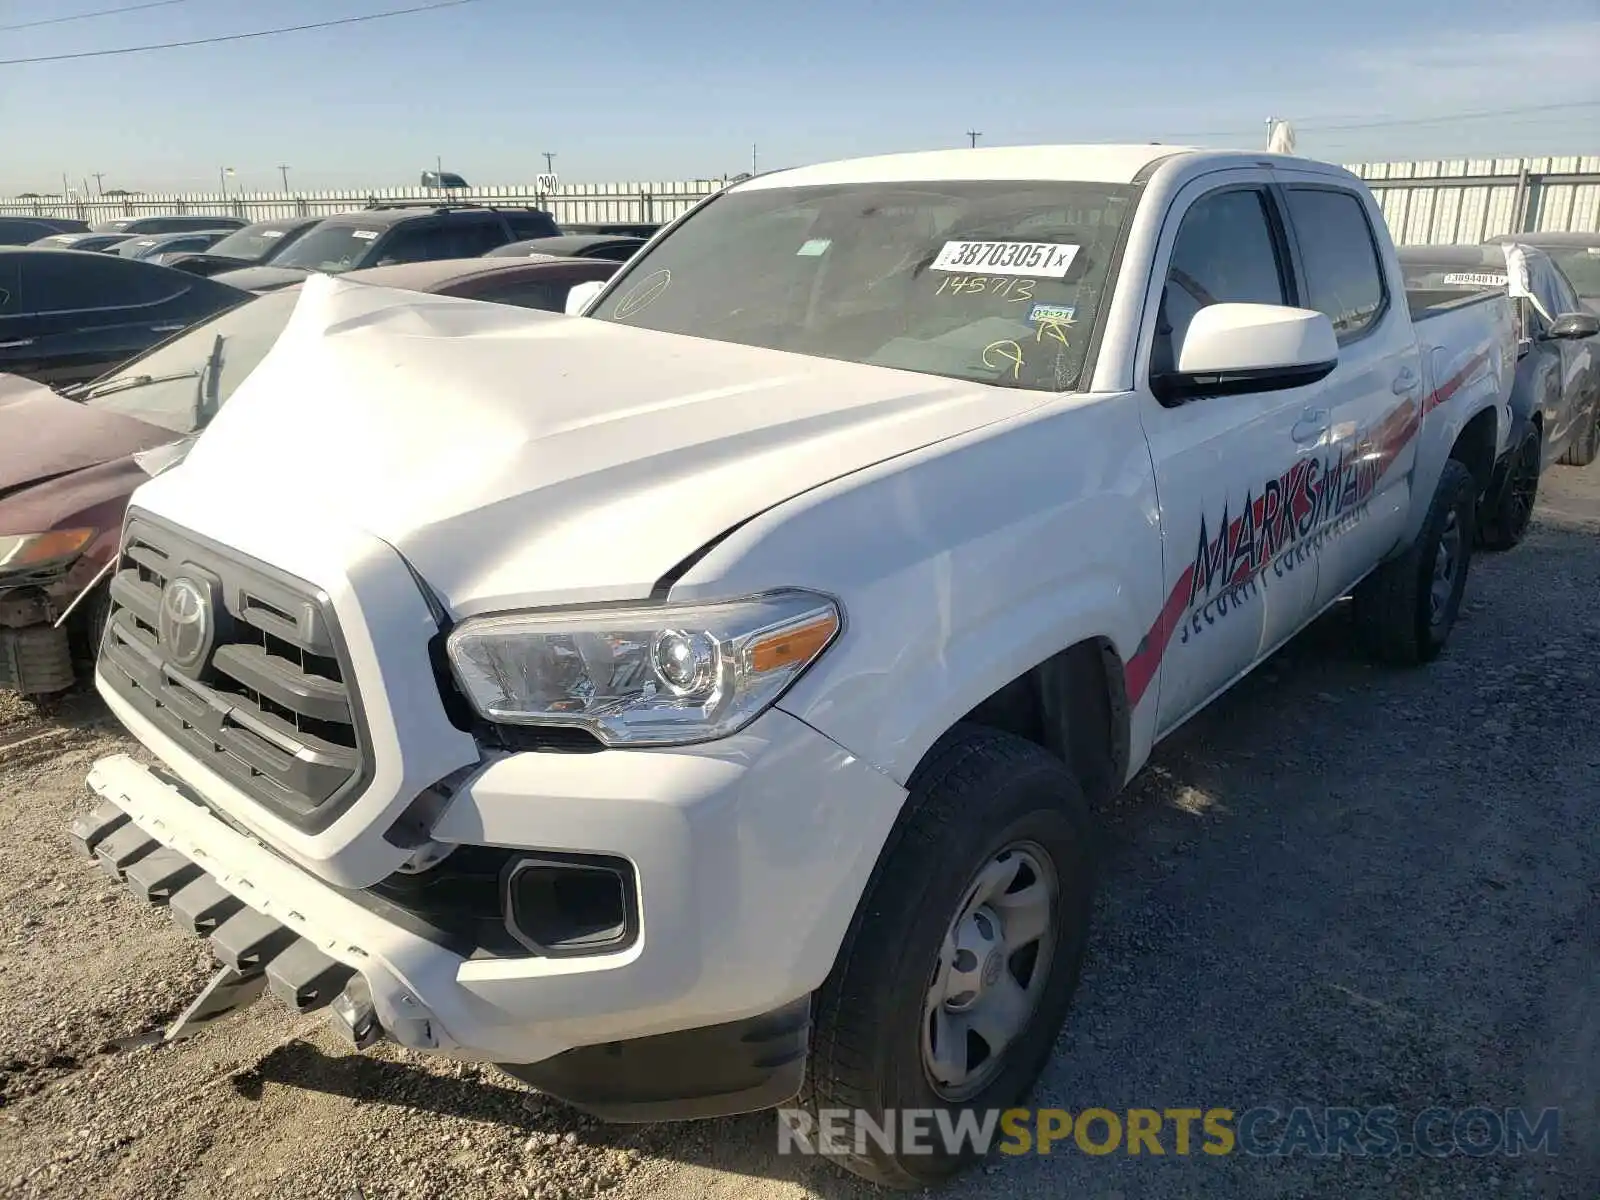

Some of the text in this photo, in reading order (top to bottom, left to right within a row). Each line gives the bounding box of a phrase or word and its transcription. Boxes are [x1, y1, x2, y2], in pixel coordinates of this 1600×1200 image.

[538, 175, 558, 197] 290
[935, 275, 1037, 303] 145713
[1189, 443, 1380, 608] MARKSMAN
